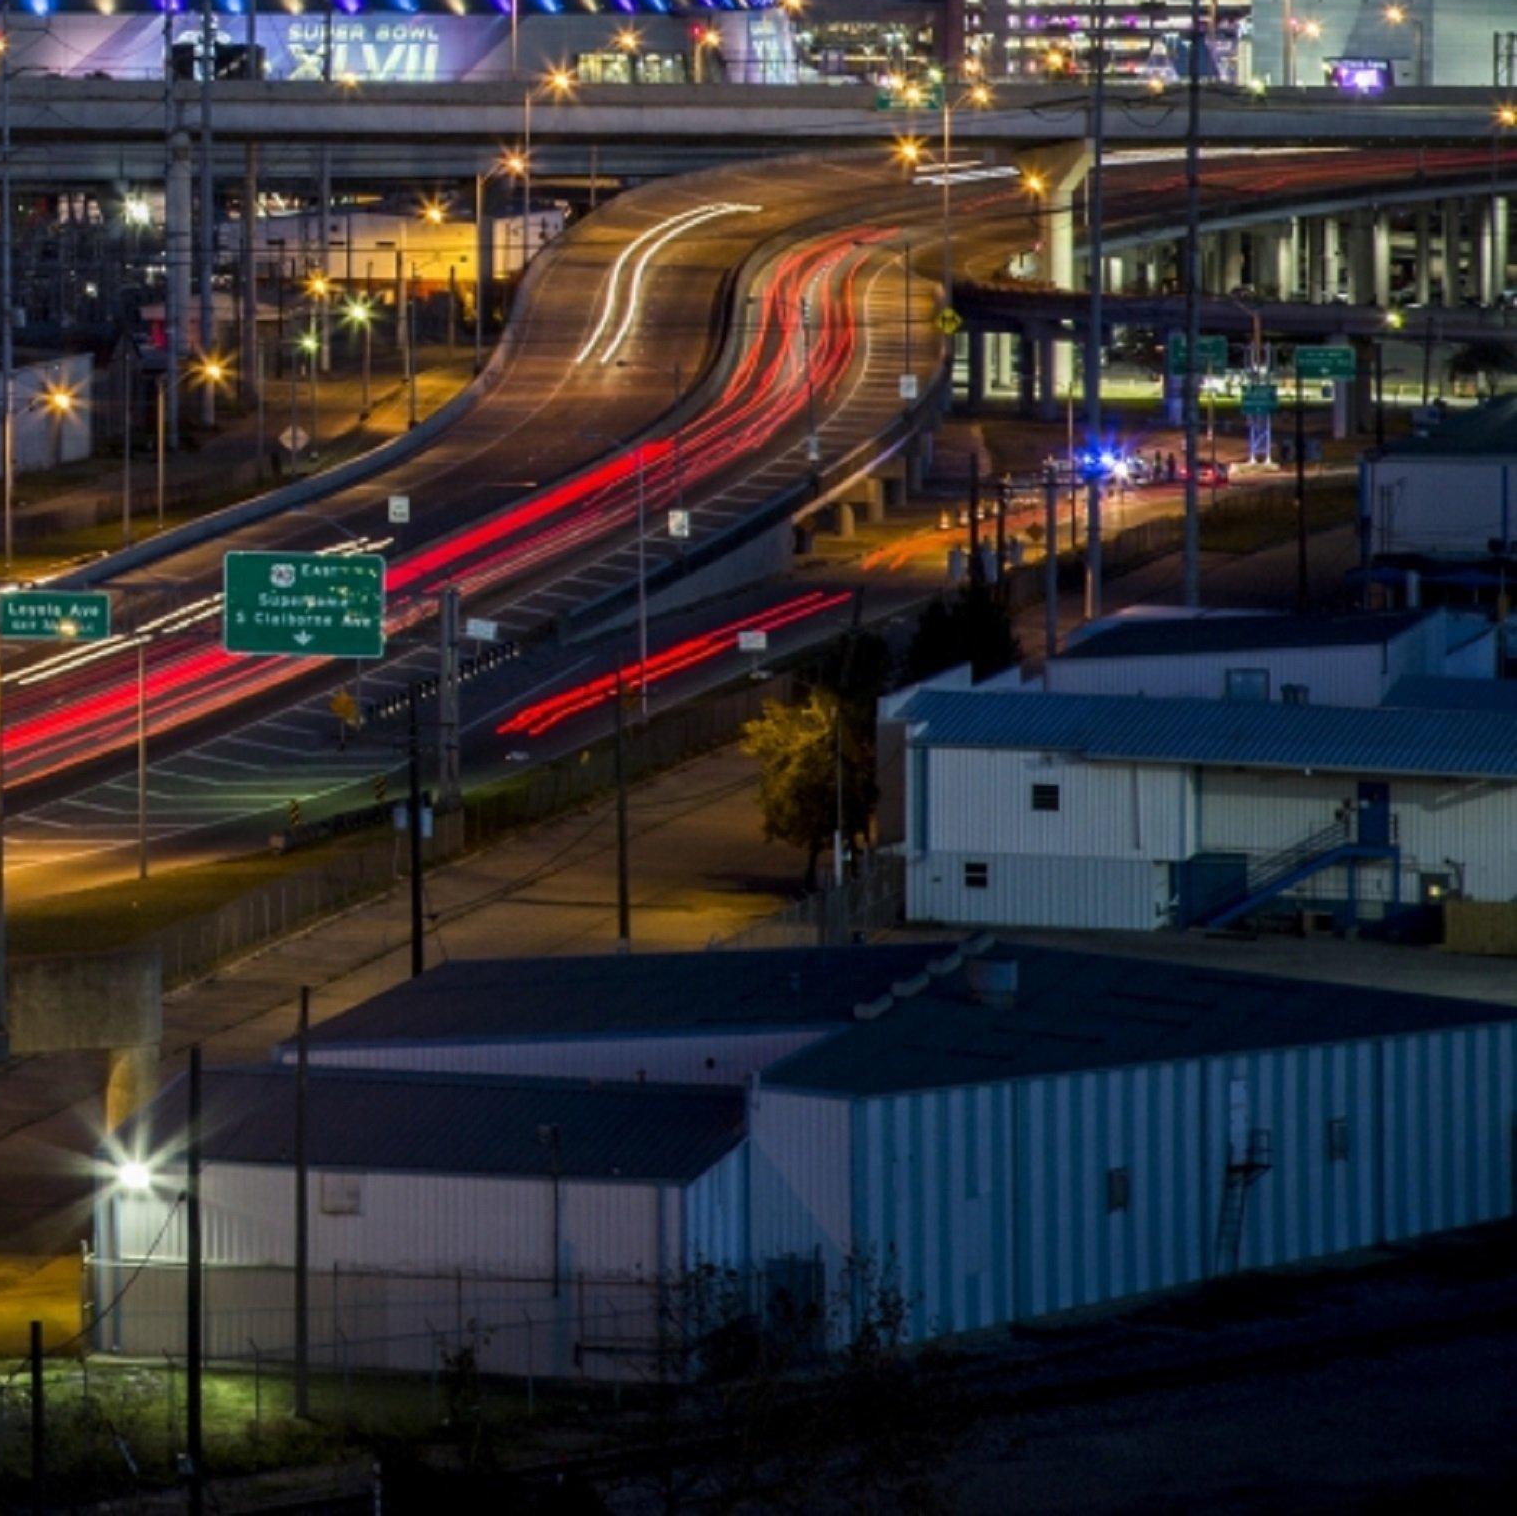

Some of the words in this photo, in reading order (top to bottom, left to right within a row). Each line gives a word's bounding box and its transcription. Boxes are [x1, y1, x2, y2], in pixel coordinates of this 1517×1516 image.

[288, 22, 365, 42] SUPER
[374, 23, 440, 42] BOWL
[287, 43, 440, 82] XLVII
[69, 603, 101, 618] Ave
[253, 611, 334, 628] Claiborne
[341, 613, 373, 628] Ave
